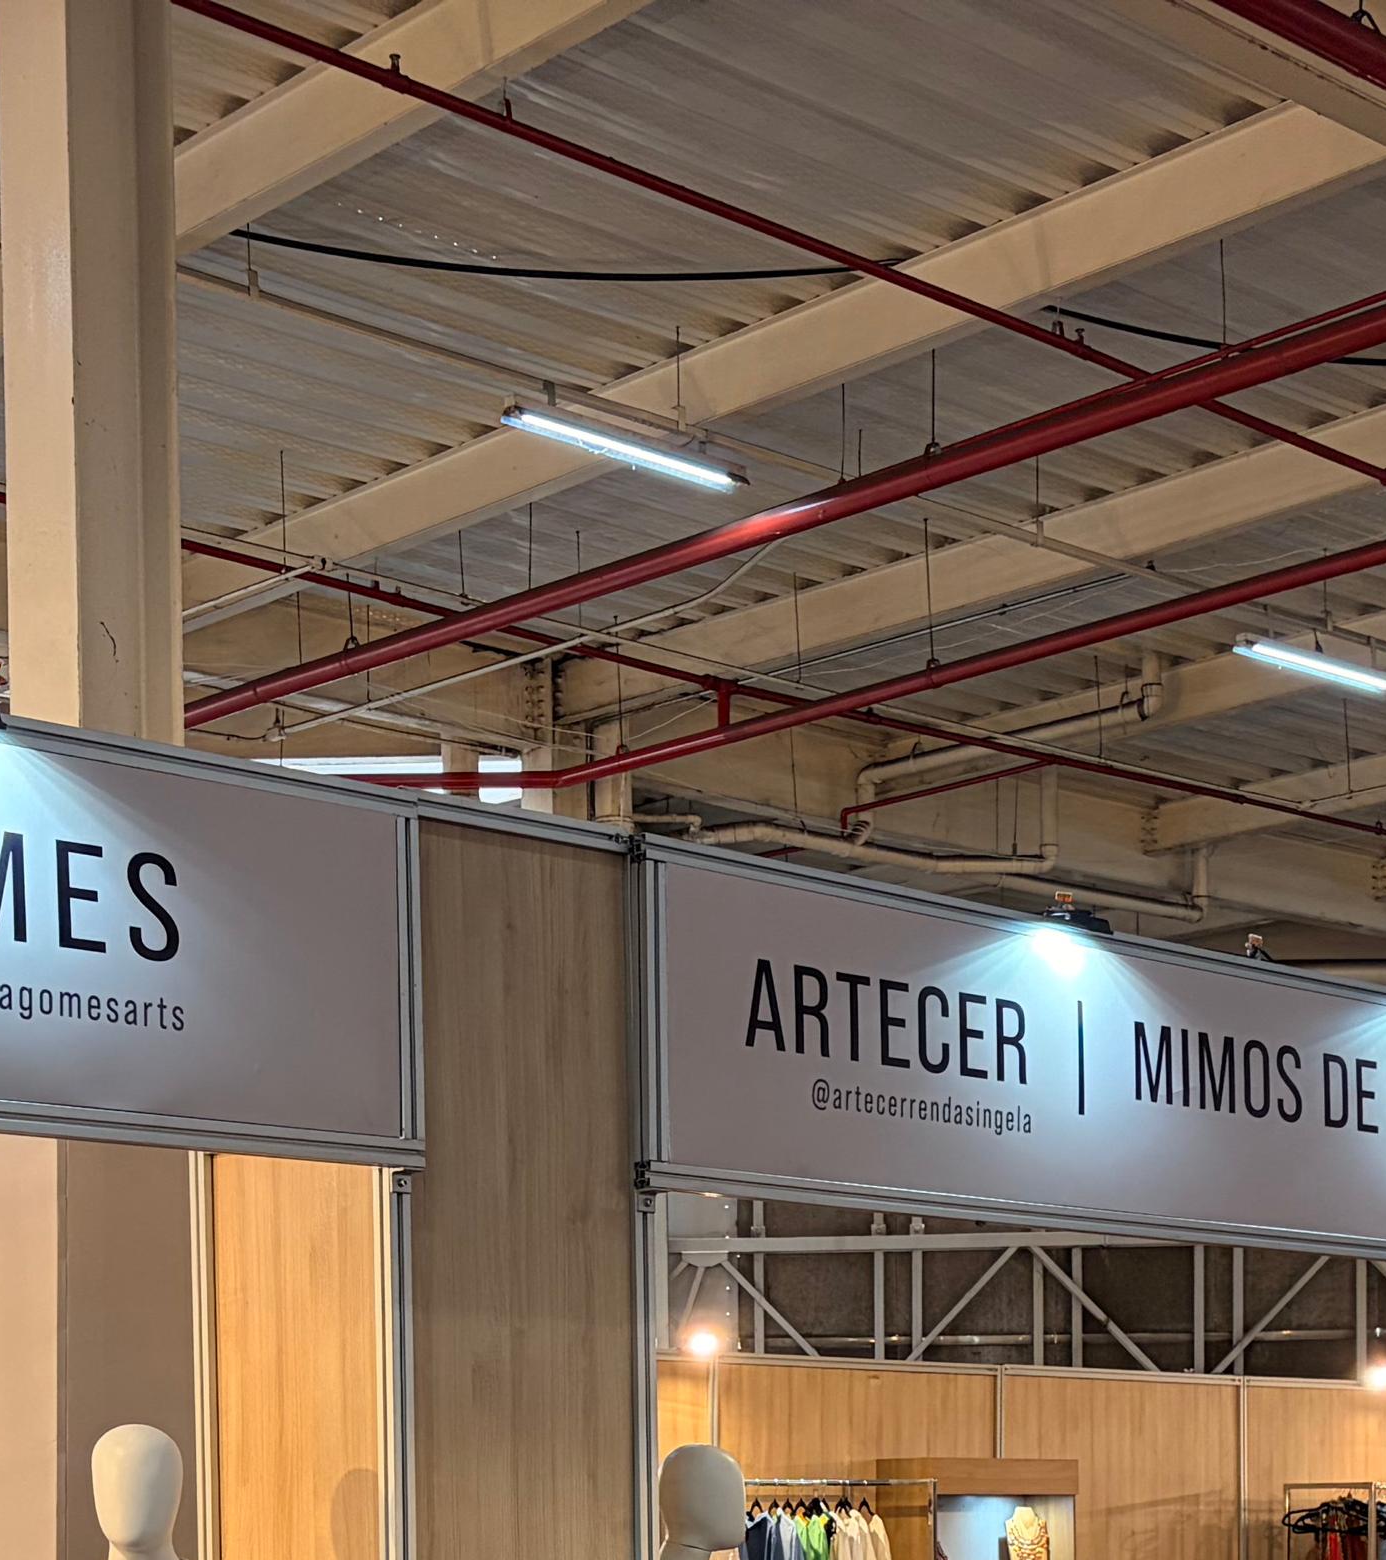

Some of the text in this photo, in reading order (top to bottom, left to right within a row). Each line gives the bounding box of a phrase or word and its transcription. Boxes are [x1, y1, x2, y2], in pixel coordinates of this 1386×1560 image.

[745, 958, 1028, 1084] ARTECER
[1133, 1020, 1303, 1123] MIMOS
[1322, 1052, 1379, 1135] DE
[812, 1078, 1032, 1136] @artecerrendasingela
